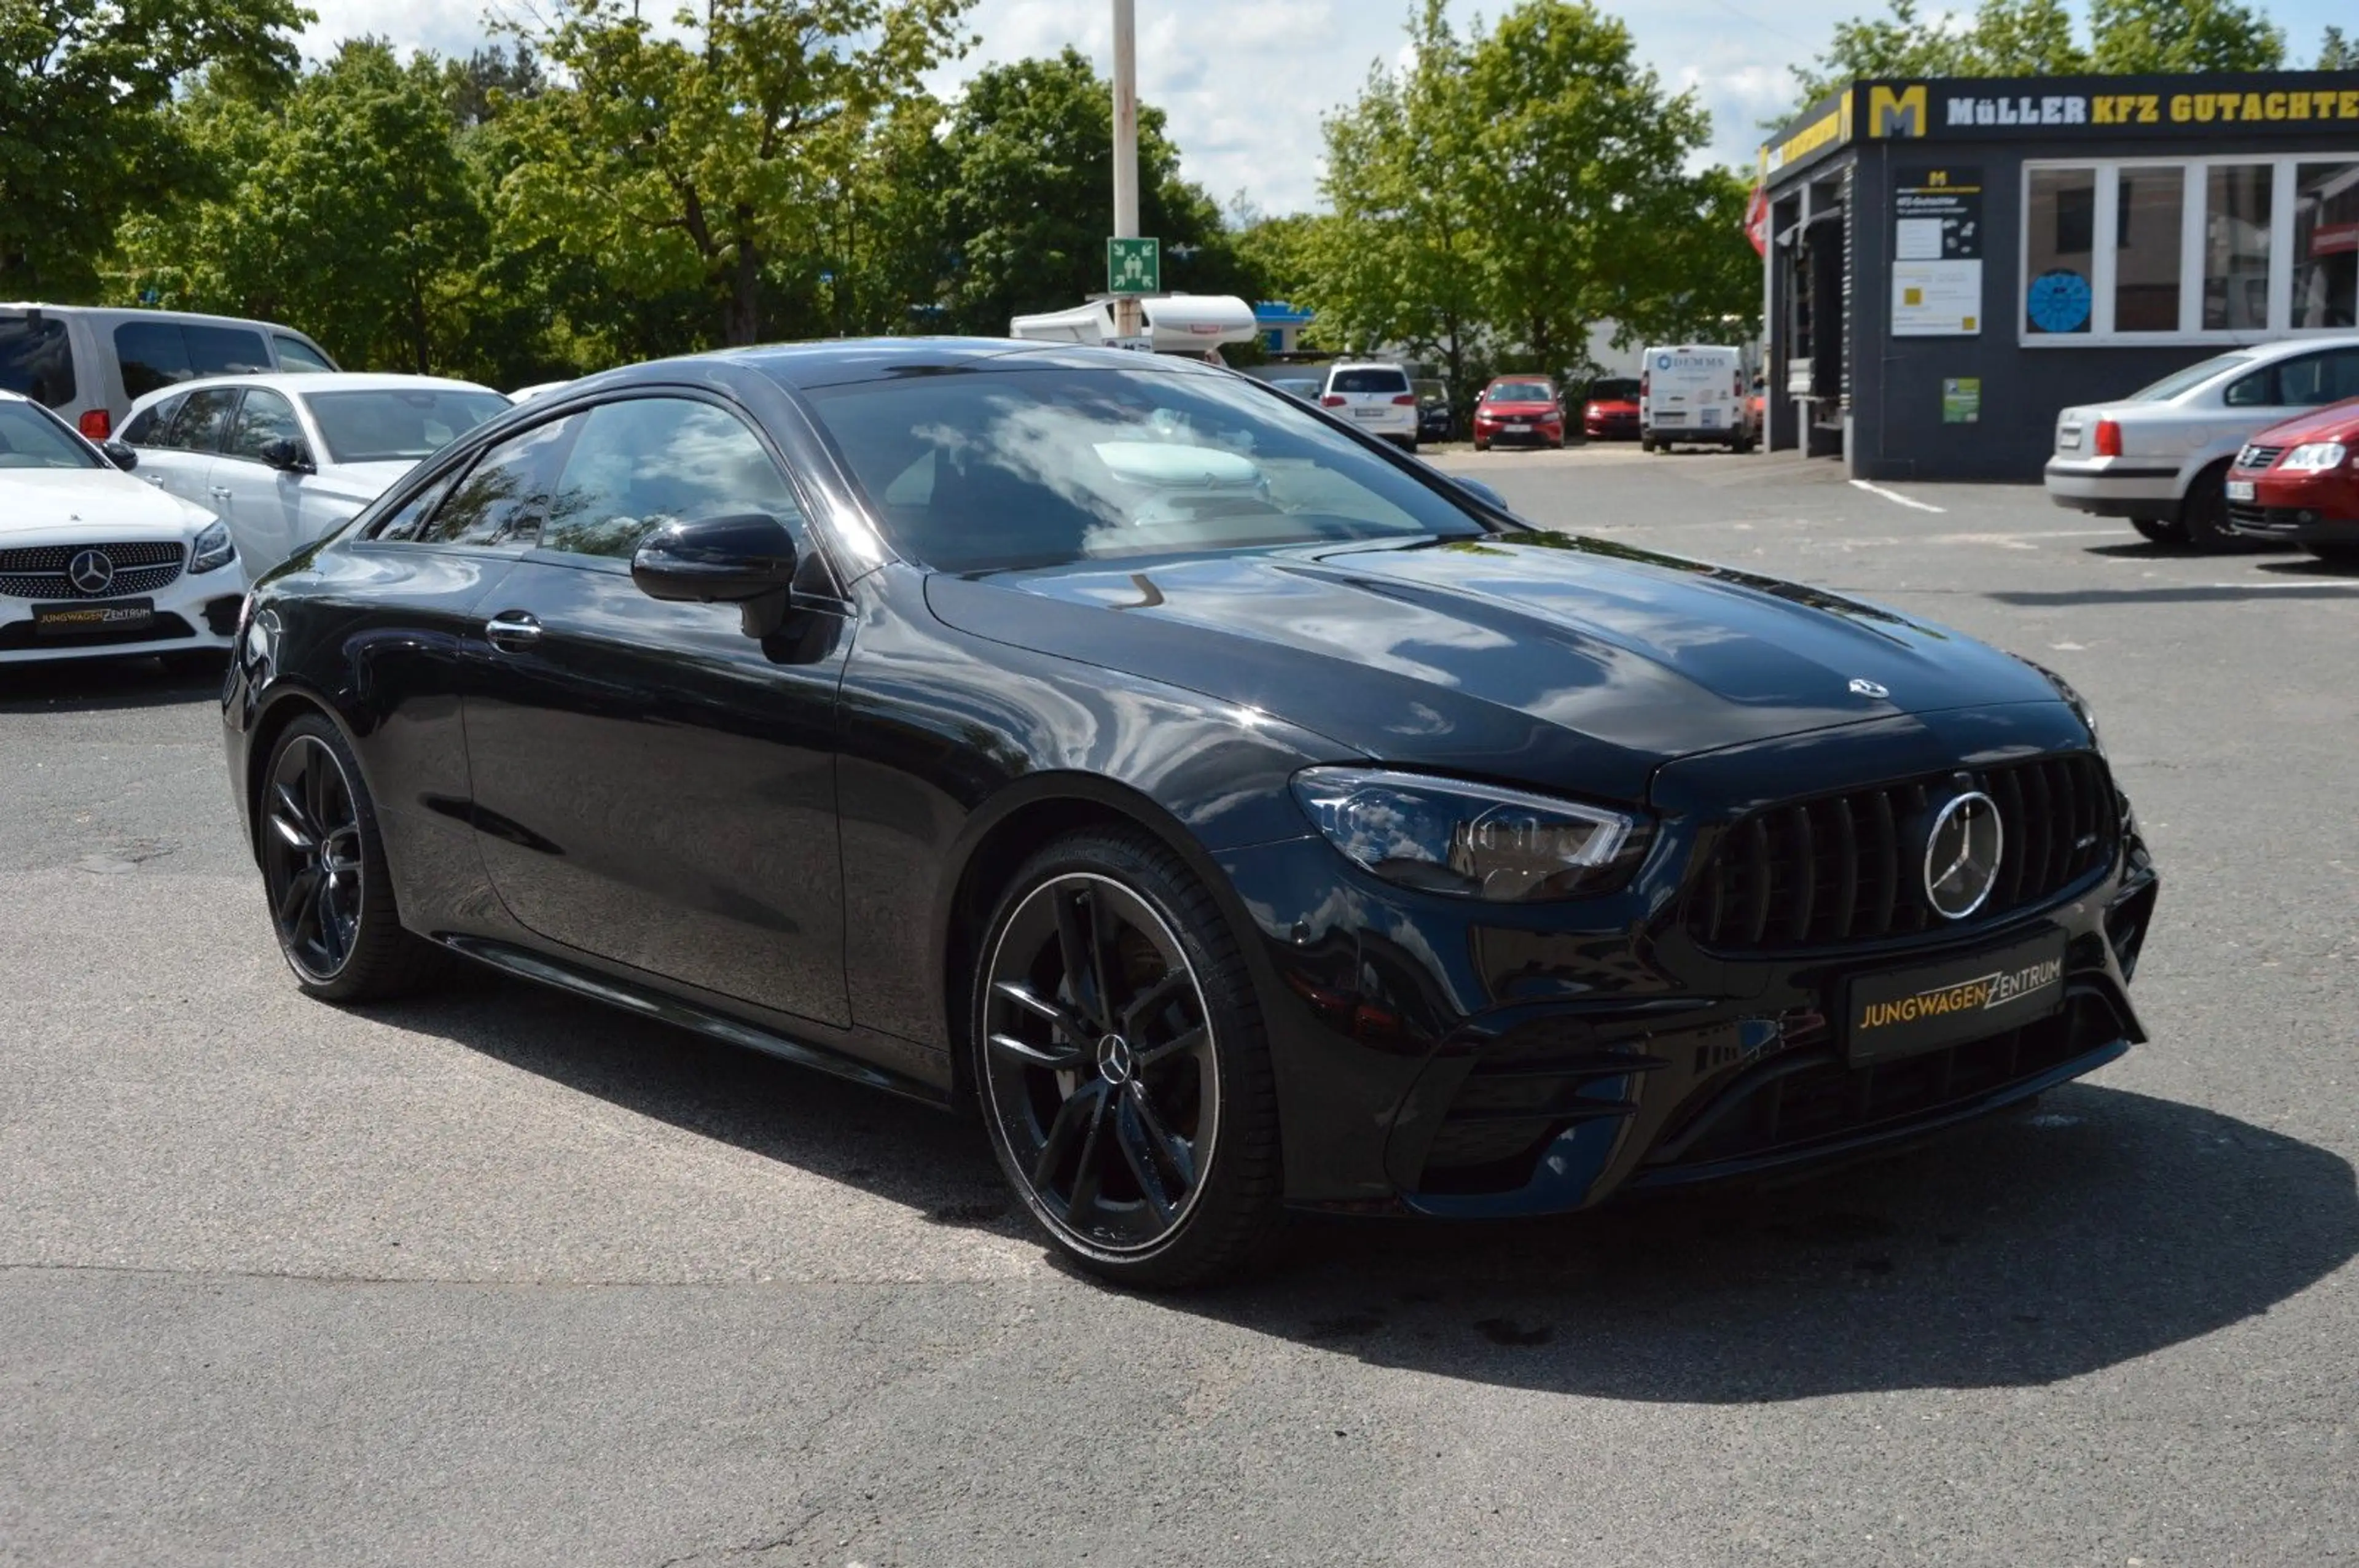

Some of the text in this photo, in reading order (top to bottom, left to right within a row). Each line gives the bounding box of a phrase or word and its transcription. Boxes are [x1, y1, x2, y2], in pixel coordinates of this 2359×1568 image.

[1869, 85, 1927, 138] M
[2091, 94, 2159, 123] KFZ
[2169, 91, 2359, 122] GUTACHTE
[39, 607, 151, 624] JUNGWAGENZENTRUM
[1860, 957, 2062, 1029] JUNGWAGENZENTRUM
